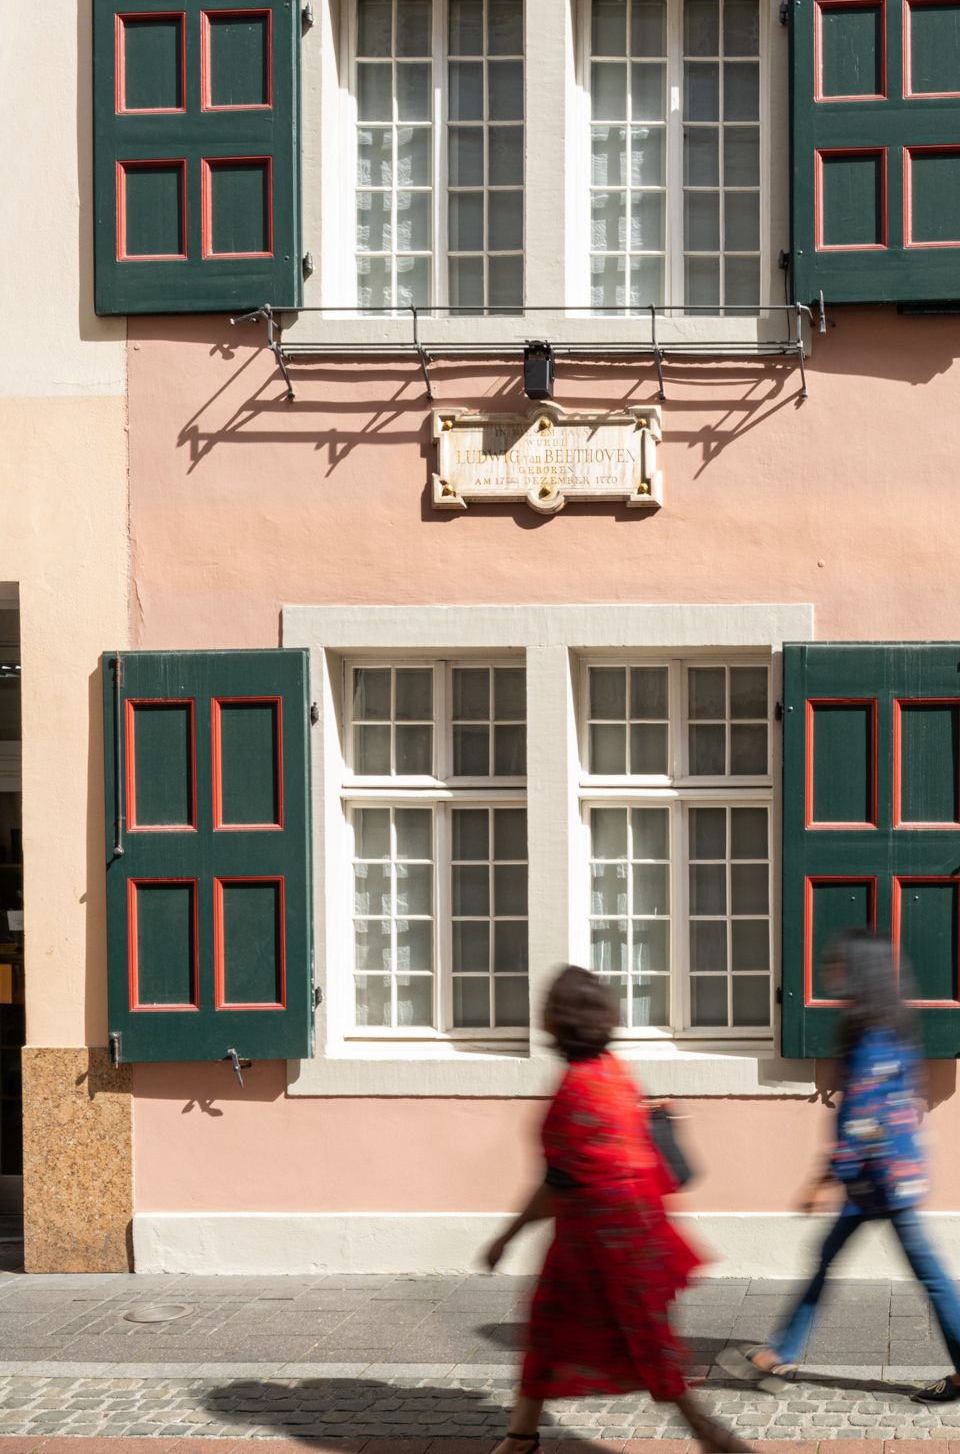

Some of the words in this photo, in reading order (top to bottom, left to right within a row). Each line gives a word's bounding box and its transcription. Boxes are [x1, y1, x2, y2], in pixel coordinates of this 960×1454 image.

[560, 427, 597, 438] HAUS
[524, 438, 568, 447] WURDE
[455, 448, 520, 465] LUDWIG
[523, 453, 541, 464] van
[543, 448, 635, 464] BEETHOVEN
[518, 466, 575, 476] GEBOREN
[475, 476, 491, 486] AM
[524, 475, 590, 486] DEZEMBER
[595, 476, 618, 485] 1770
